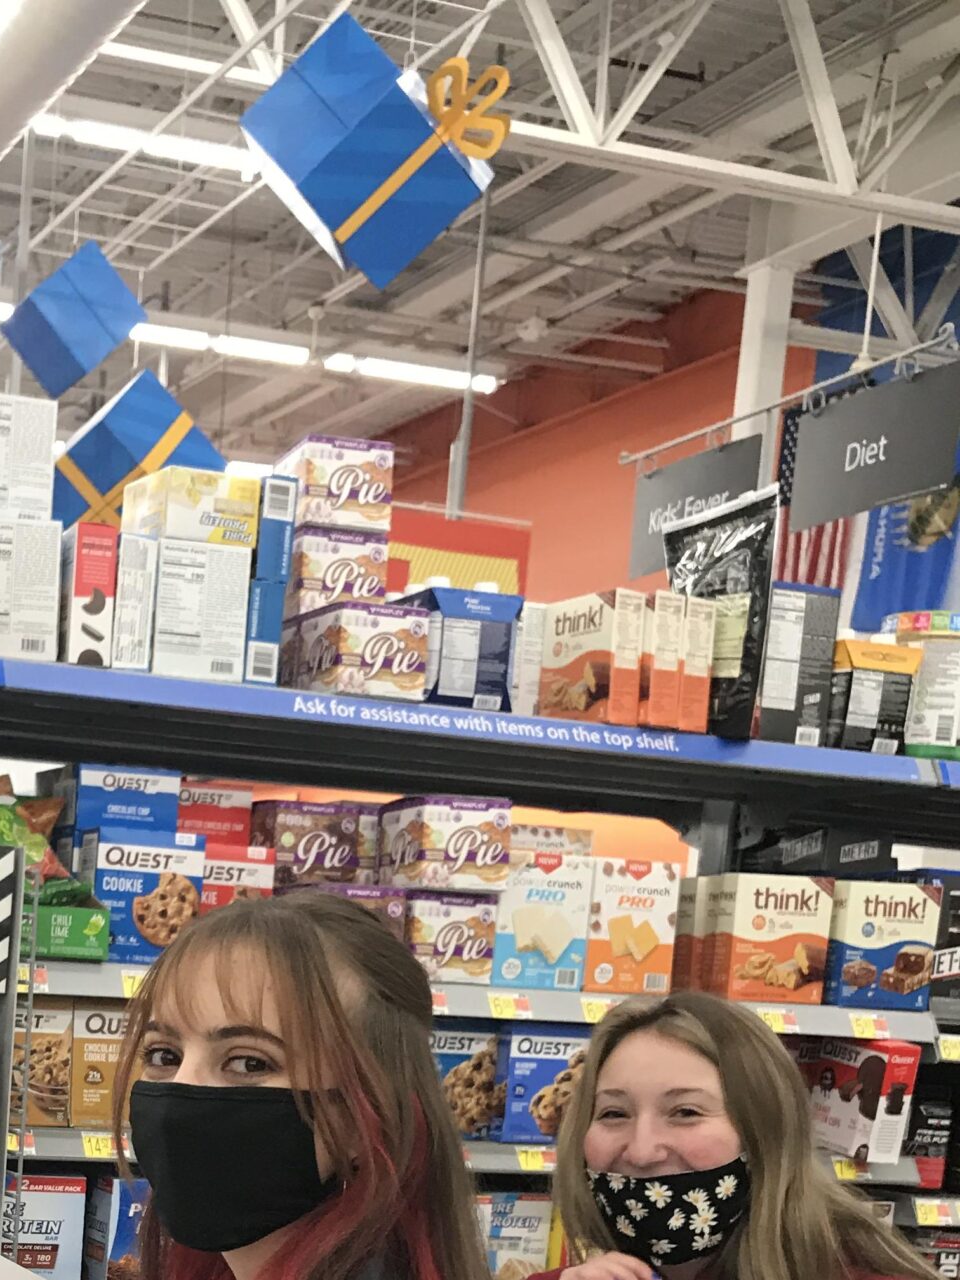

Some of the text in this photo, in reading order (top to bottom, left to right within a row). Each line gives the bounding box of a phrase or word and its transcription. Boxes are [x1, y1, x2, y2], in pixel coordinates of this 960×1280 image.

[844, 435, 888, 472] Diet
[327, 464, 386, 509] Pie
[322, 559, 382, 603] Pie
[554, 604, 604, 638] think!
[363, 631, 421, 679] Pie
[294, 696, 679, 752] Ask for assistance with items on the top shelf.
[103, 774, 150, 791] QUEST
[179, 789, 224, 805] QUEST
[105, 846, 174, 870] QUEST
[293, 831, 352, 874] Pie
[446, 826, 504, 872] Pie
[102, 877, 143, 893] COOKIE
[525, 888, 565, 903] PRO
[617, 895, 655, 909] PRO
[754, 887, 820, 912] think!
[864, 895, 927, 920] think!
[51, 927, 69, 937] LIME
[437, 921, 488, 967] Pie
[518, 1037, 570, 1055] QUEST
